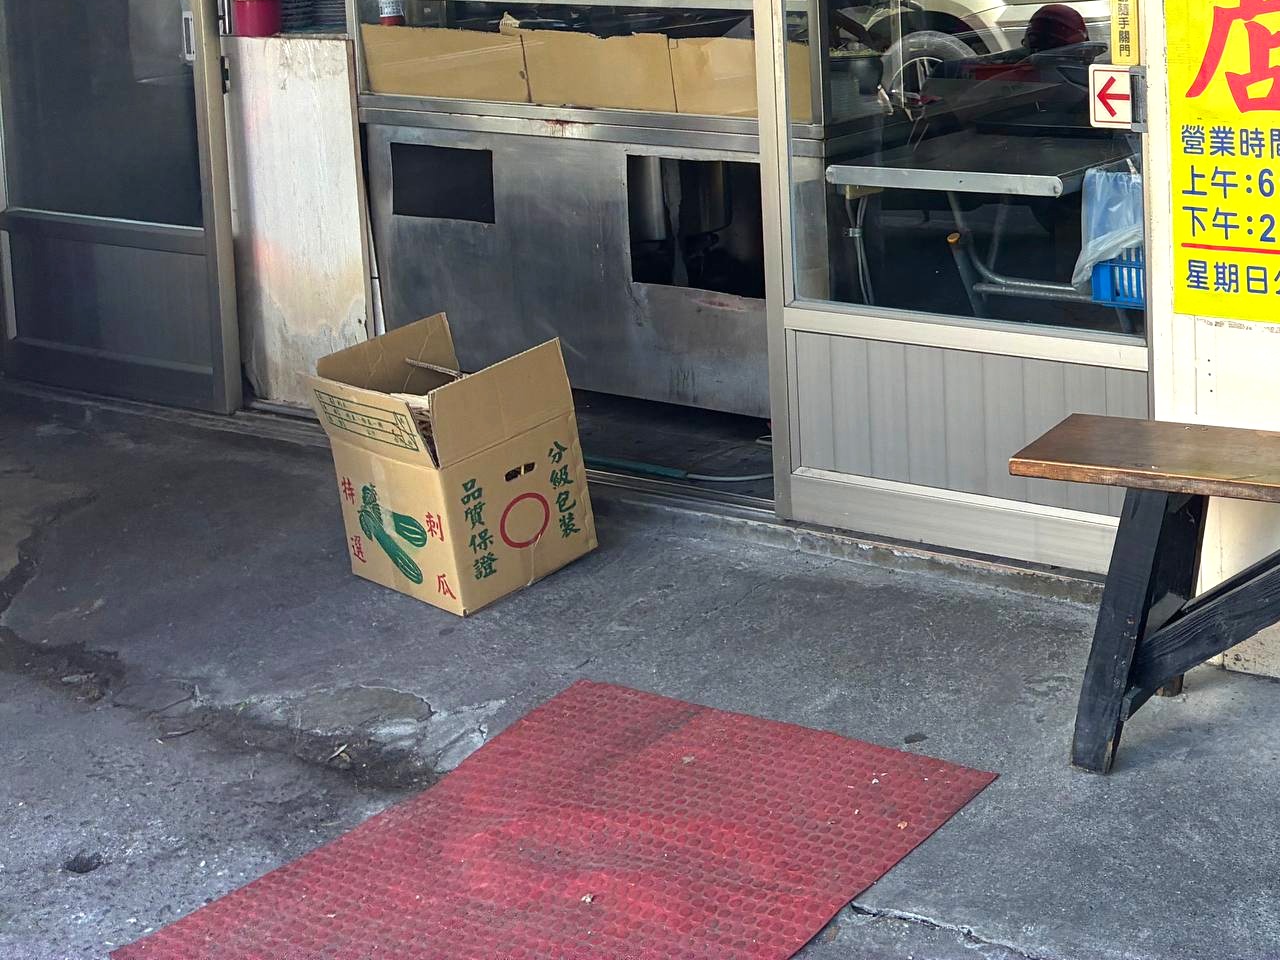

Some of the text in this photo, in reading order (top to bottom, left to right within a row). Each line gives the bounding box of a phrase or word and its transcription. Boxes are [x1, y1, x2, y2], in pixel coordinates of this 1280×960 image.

[341, 476, 367, 564] 特選
[460, 478, 499, 581] 品質保證
[548, 441, 581, 539] 分級包裝
[425, 512, 457, 600] 刺瓜
